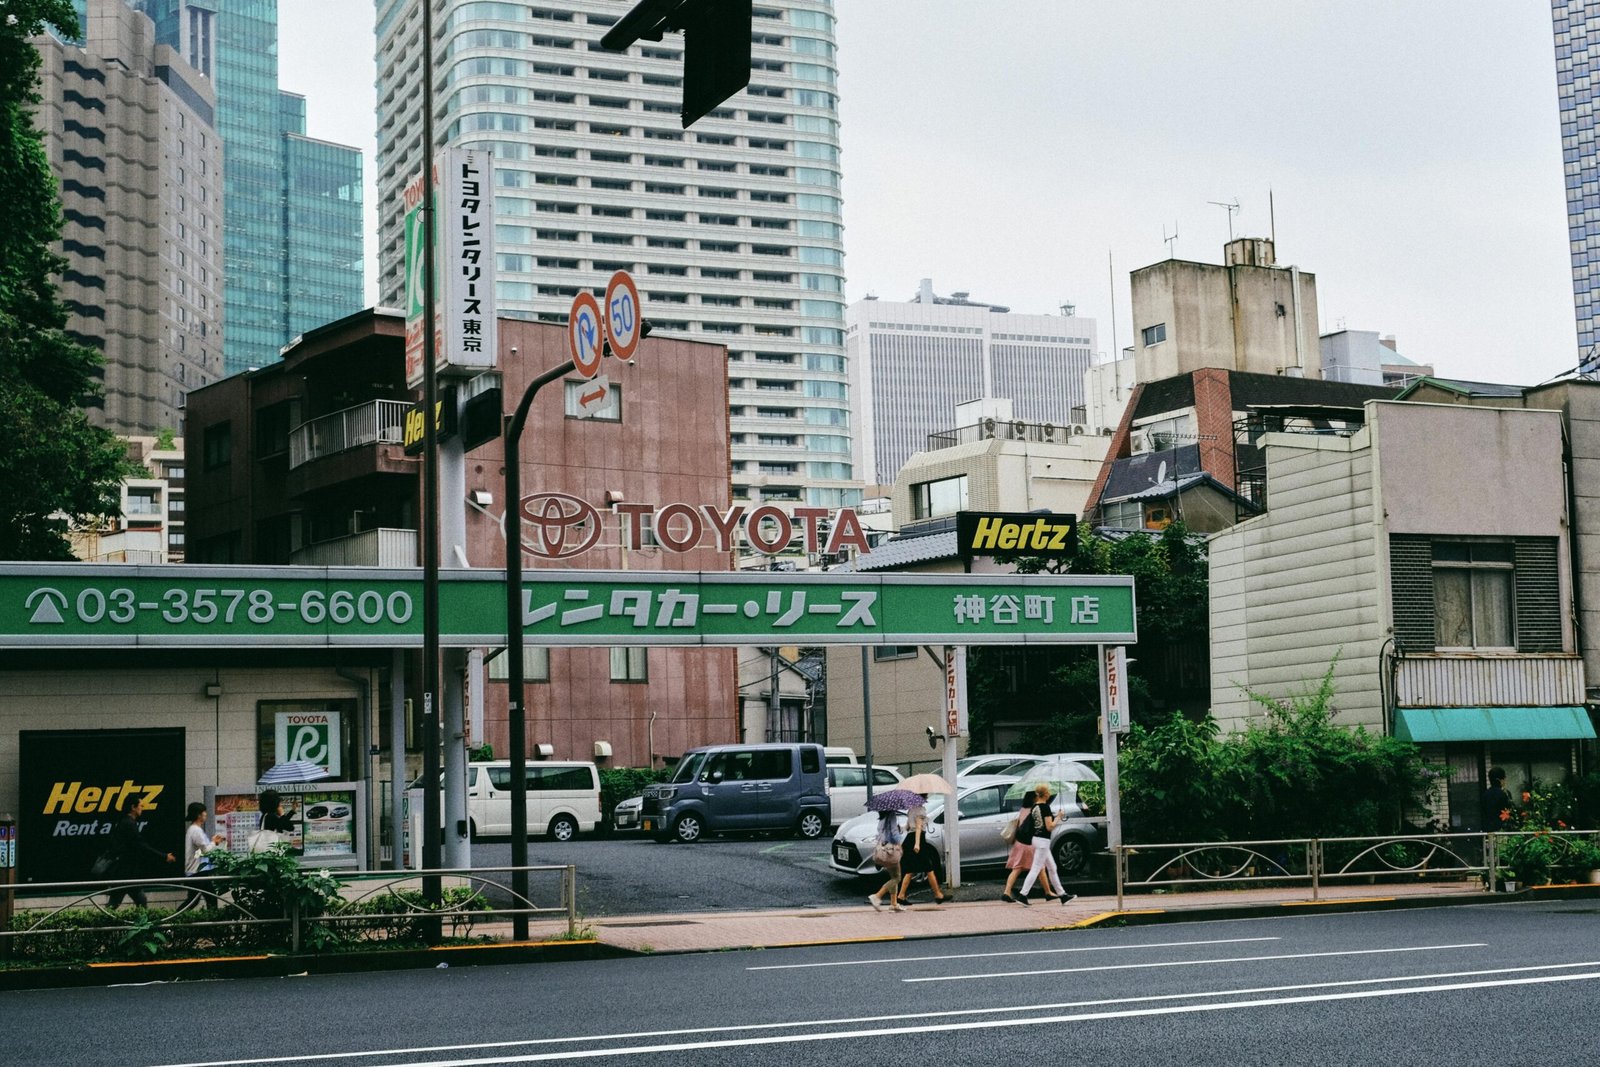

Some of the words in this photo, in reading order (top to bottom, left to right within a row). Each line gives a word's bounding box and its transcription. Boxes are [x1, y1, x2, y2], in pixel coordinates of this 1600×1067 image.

[461, 164, 482, 352] トヨタレンタリース東京
[611, 294, 632, 337] 50
[612, 502, 872, 555] TOYOTA
[971, 517, 1071, 550] Hertz
[76, 587, 413, 624] 03-3578-6600
[953, 594, 1056, 624] 神谷町
[947, 652, 956, 709] レンタカー
[1107, 651, 1117, 706] レンタカー
[287, 715, 329, 724] TOYOTA
[42, 780, 165, 815] Hertz
[52, 820, 99, 837] Rent
[100, 822, 113, 835] a
